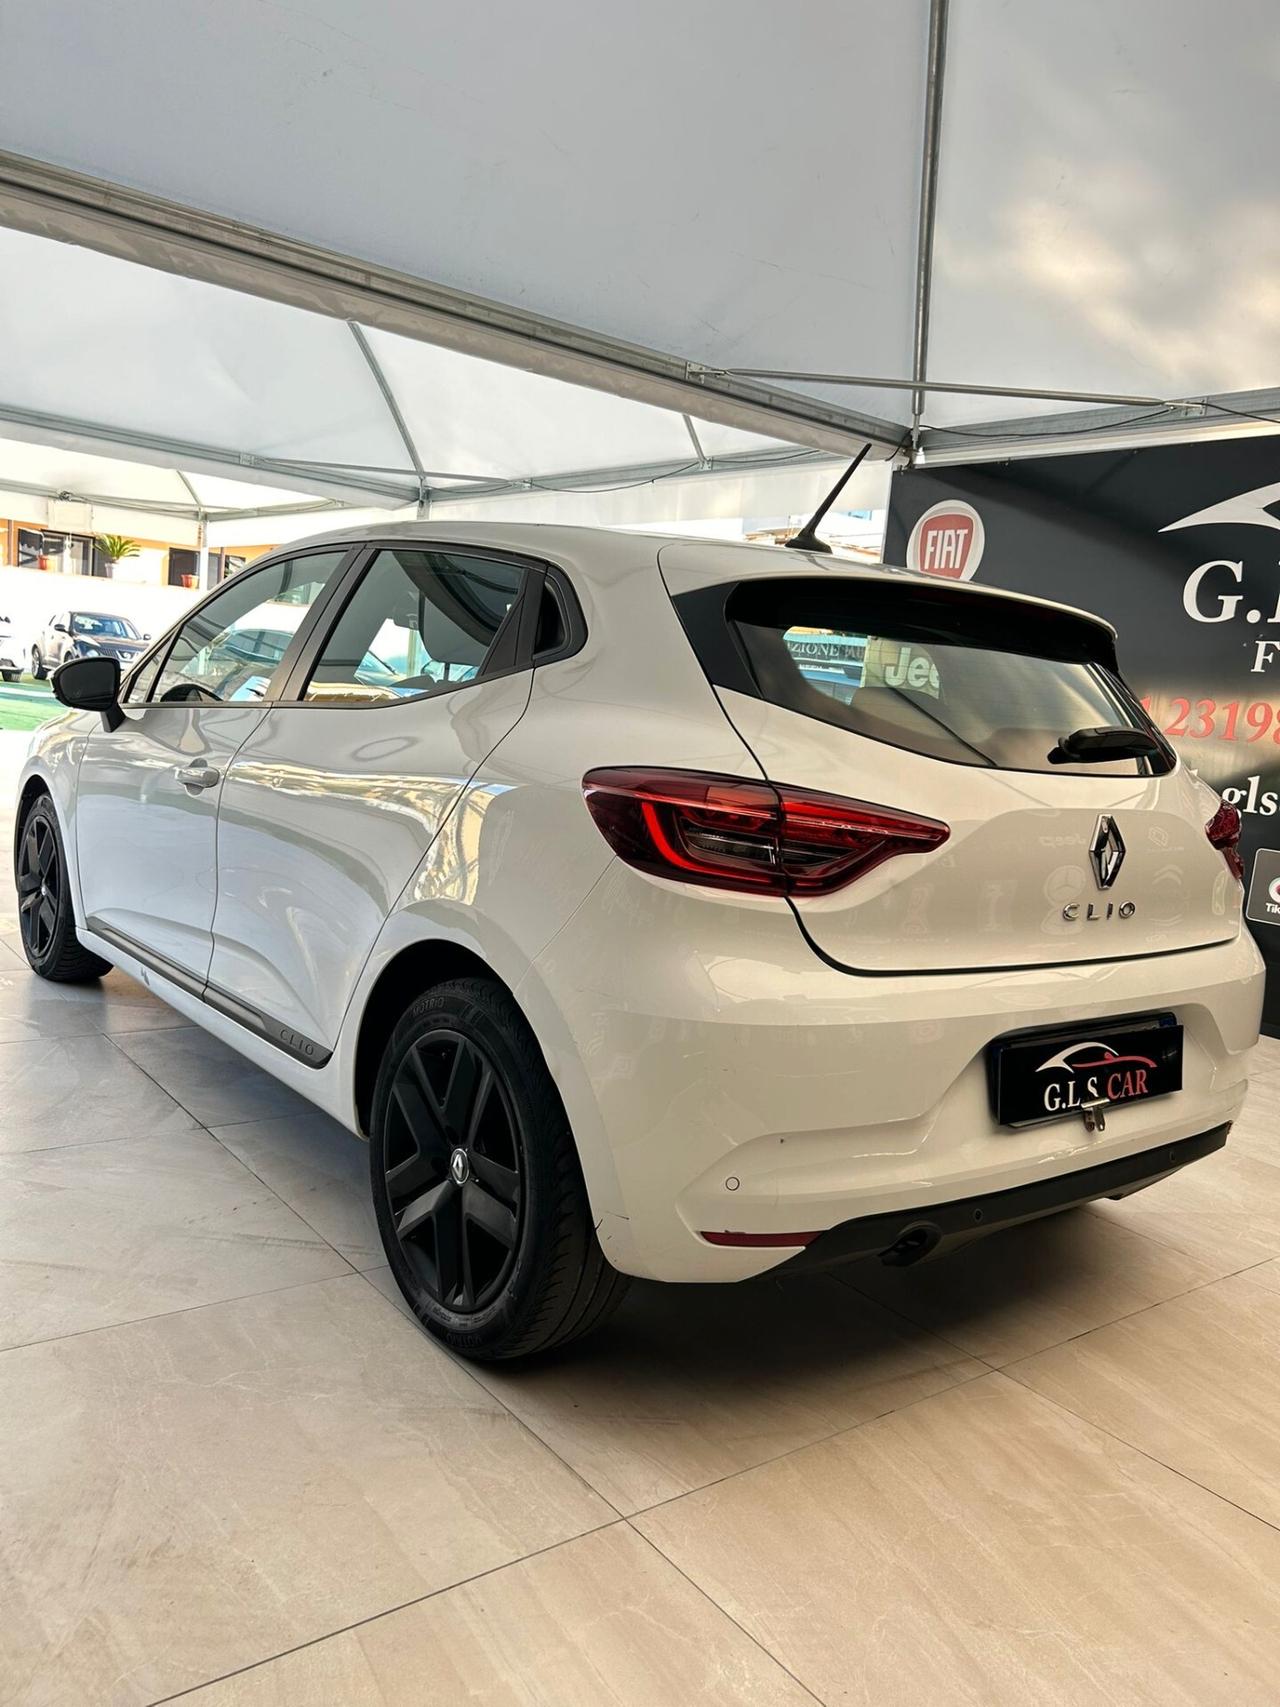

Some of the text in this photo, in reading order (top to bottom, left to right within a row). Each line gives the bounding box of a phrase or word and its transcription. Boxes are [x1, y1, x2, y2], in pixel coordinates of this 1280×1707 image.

[924, 529, 969, 570] FIAT
[1183, 560, 1280, 623] G.
[787, 642, 840, 657] ZIONE
[1164, 696, 1280, 745] 2319
[1062, 900, 1136, 921] CLIO
[280, 1029, 314, 1056] CLIO
[1044, 1069, 1149, 1111] G.LS CAR
